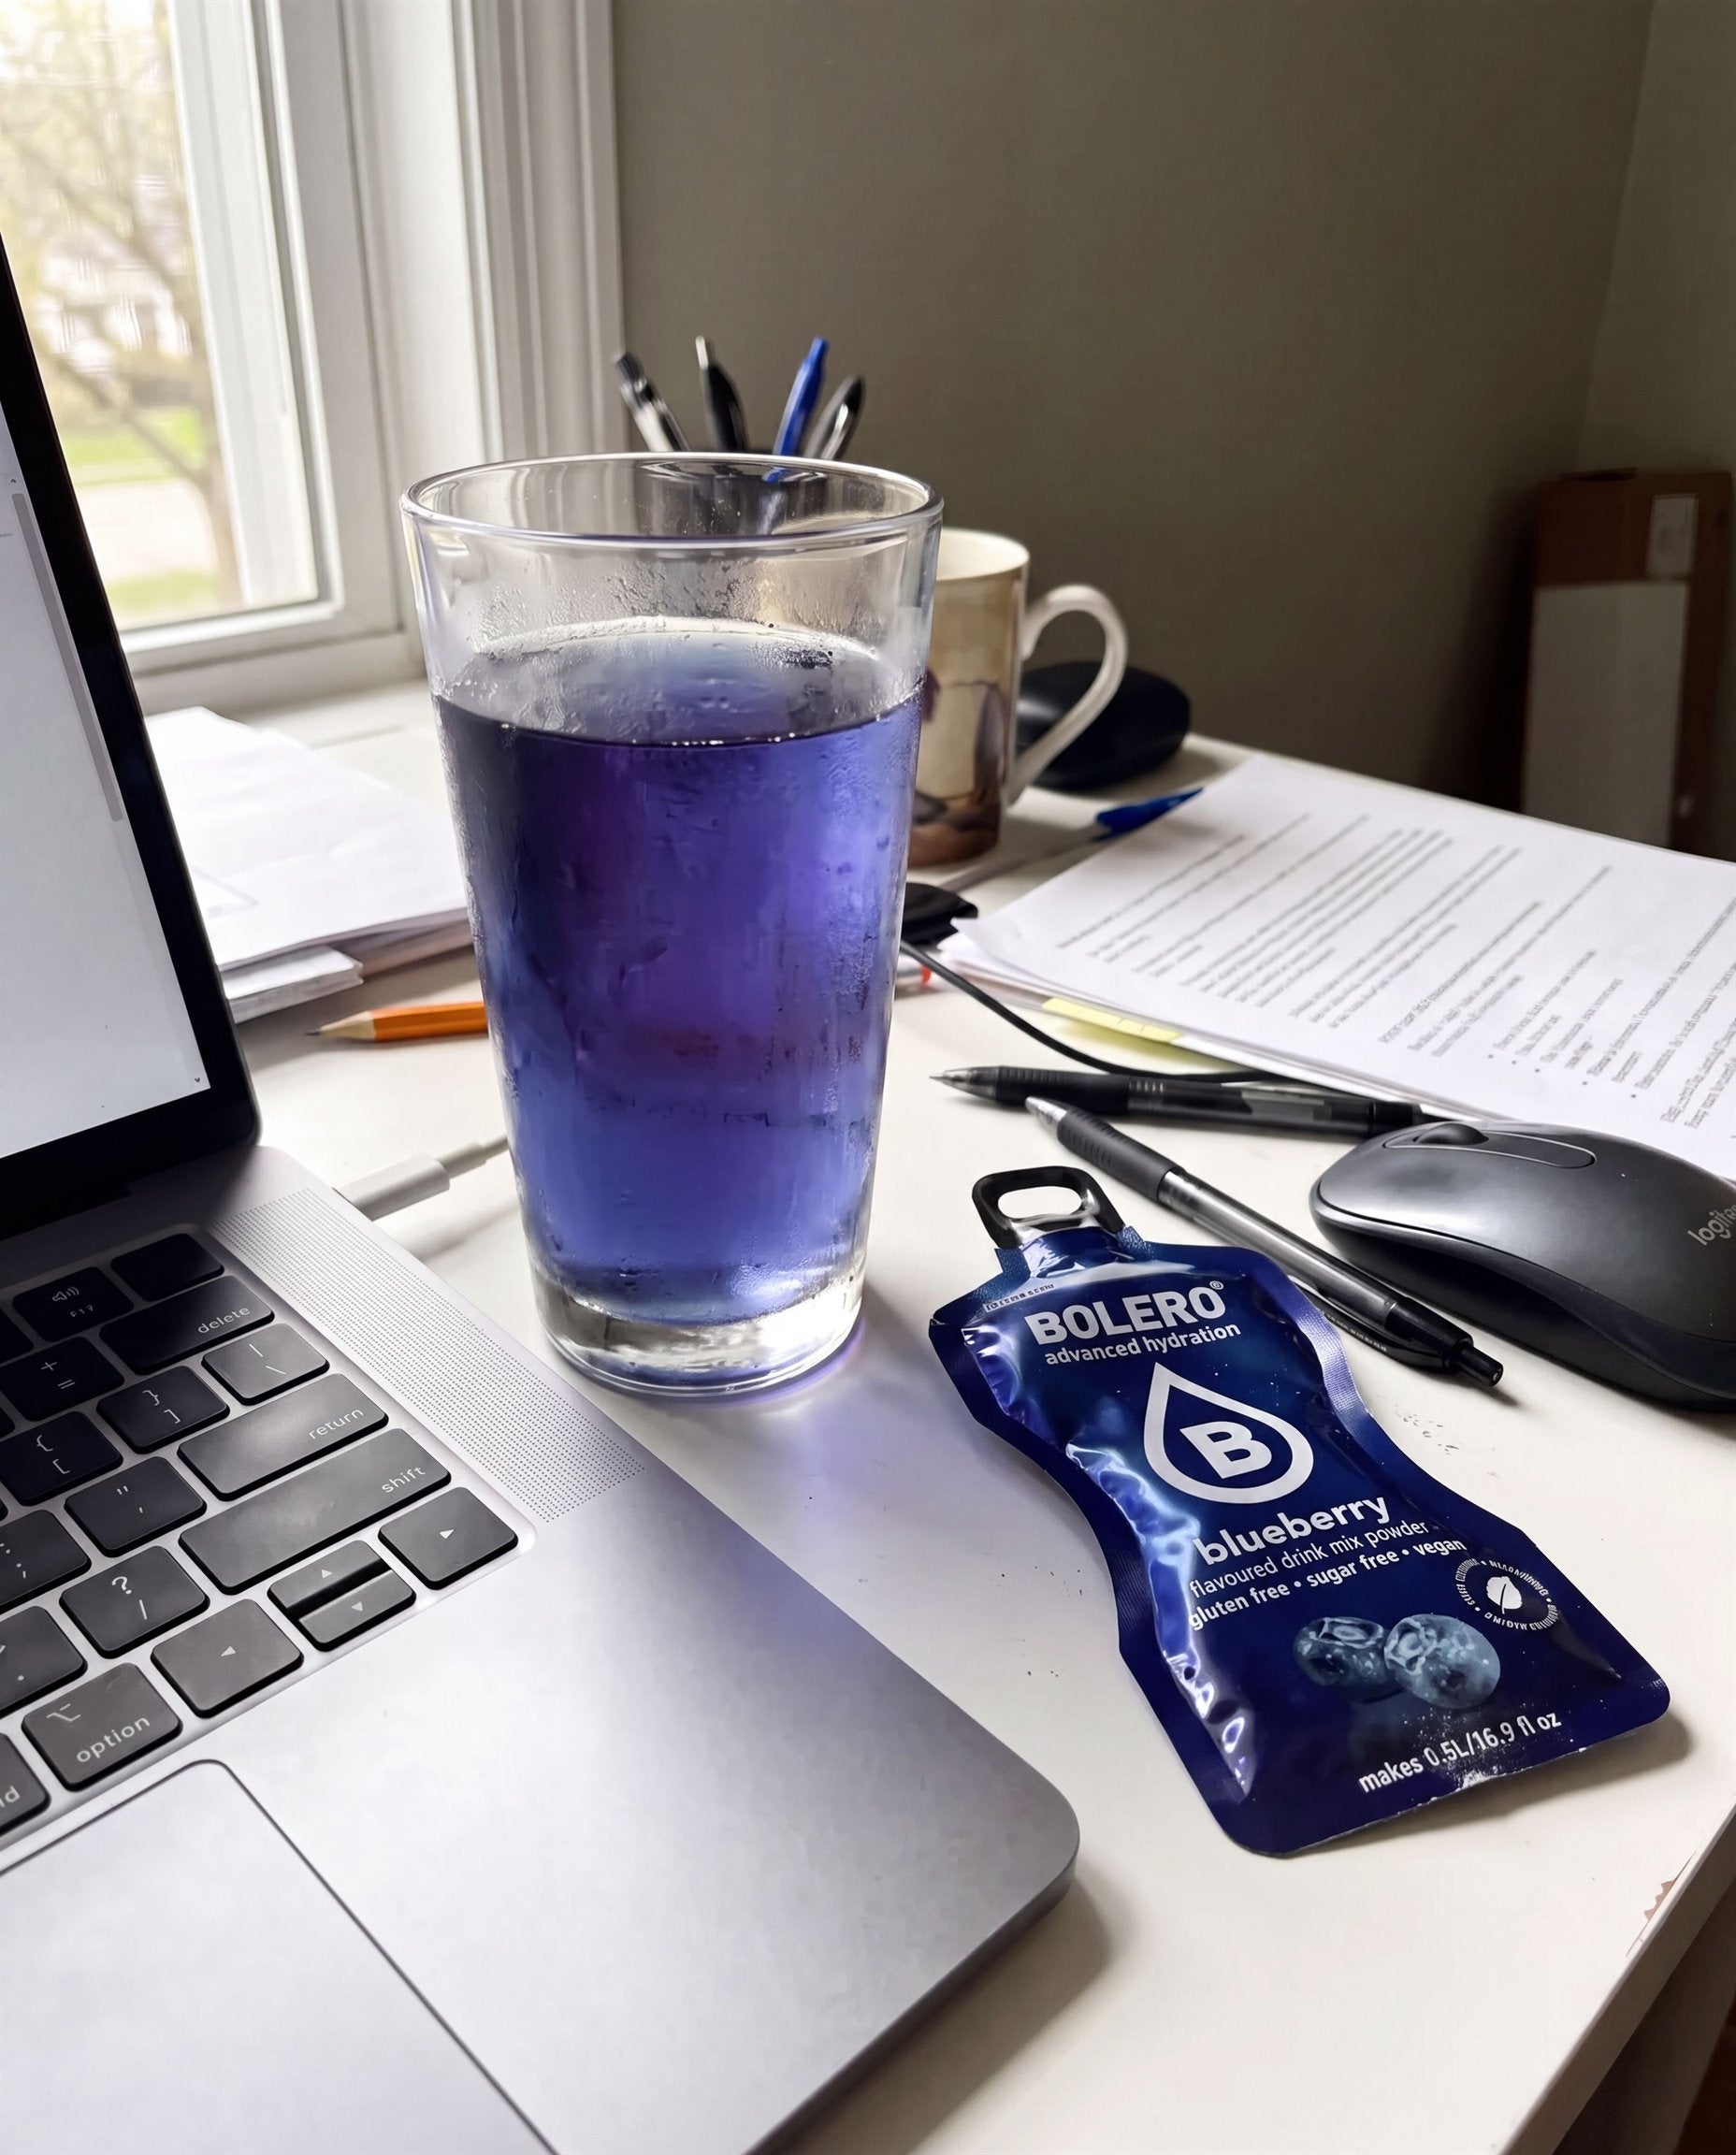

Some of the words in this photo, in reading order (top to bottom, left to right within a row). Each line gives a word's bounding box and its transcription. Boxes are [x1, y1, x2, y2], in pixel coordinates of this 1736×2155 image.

[197, 1308, 251, 1334] delete
[1044, 1338, 1142, 1366] advanced
[1142, 1323, 1242, 1353] hydration
[309, 1409, 364, 1439] return
[1179, 1421, 1272, 1479] B
[382, 1467, 426, 1493] shift
[1192, 1497, 1390, 1566] blueberry
[1189, 1555, 1279, 1598] flavoured
[1280, 1542, 1329, 1569] drink
[1329, 1535, 1364, 1555] mix
[1365, 1519, 1429, 1549] powder
[1189, 1596, 1250, 1631] gluten
[1250, 1584, 1291, 1604] free
[1306, 1562, 1358, 1587] sugar
[1359, 1550, 1400, 1570] free
[1412, 1540, 1468, 1556] vegan
[77, 1717, 151, 1763] option
[1358, 1757, 1425, 1793] makes
[1423, 1722, 1515, 1767] 0.5L/16.9
[1516, 1714, 1537, 1737] fl
[1537, 1713, 1562, 1730] oz
